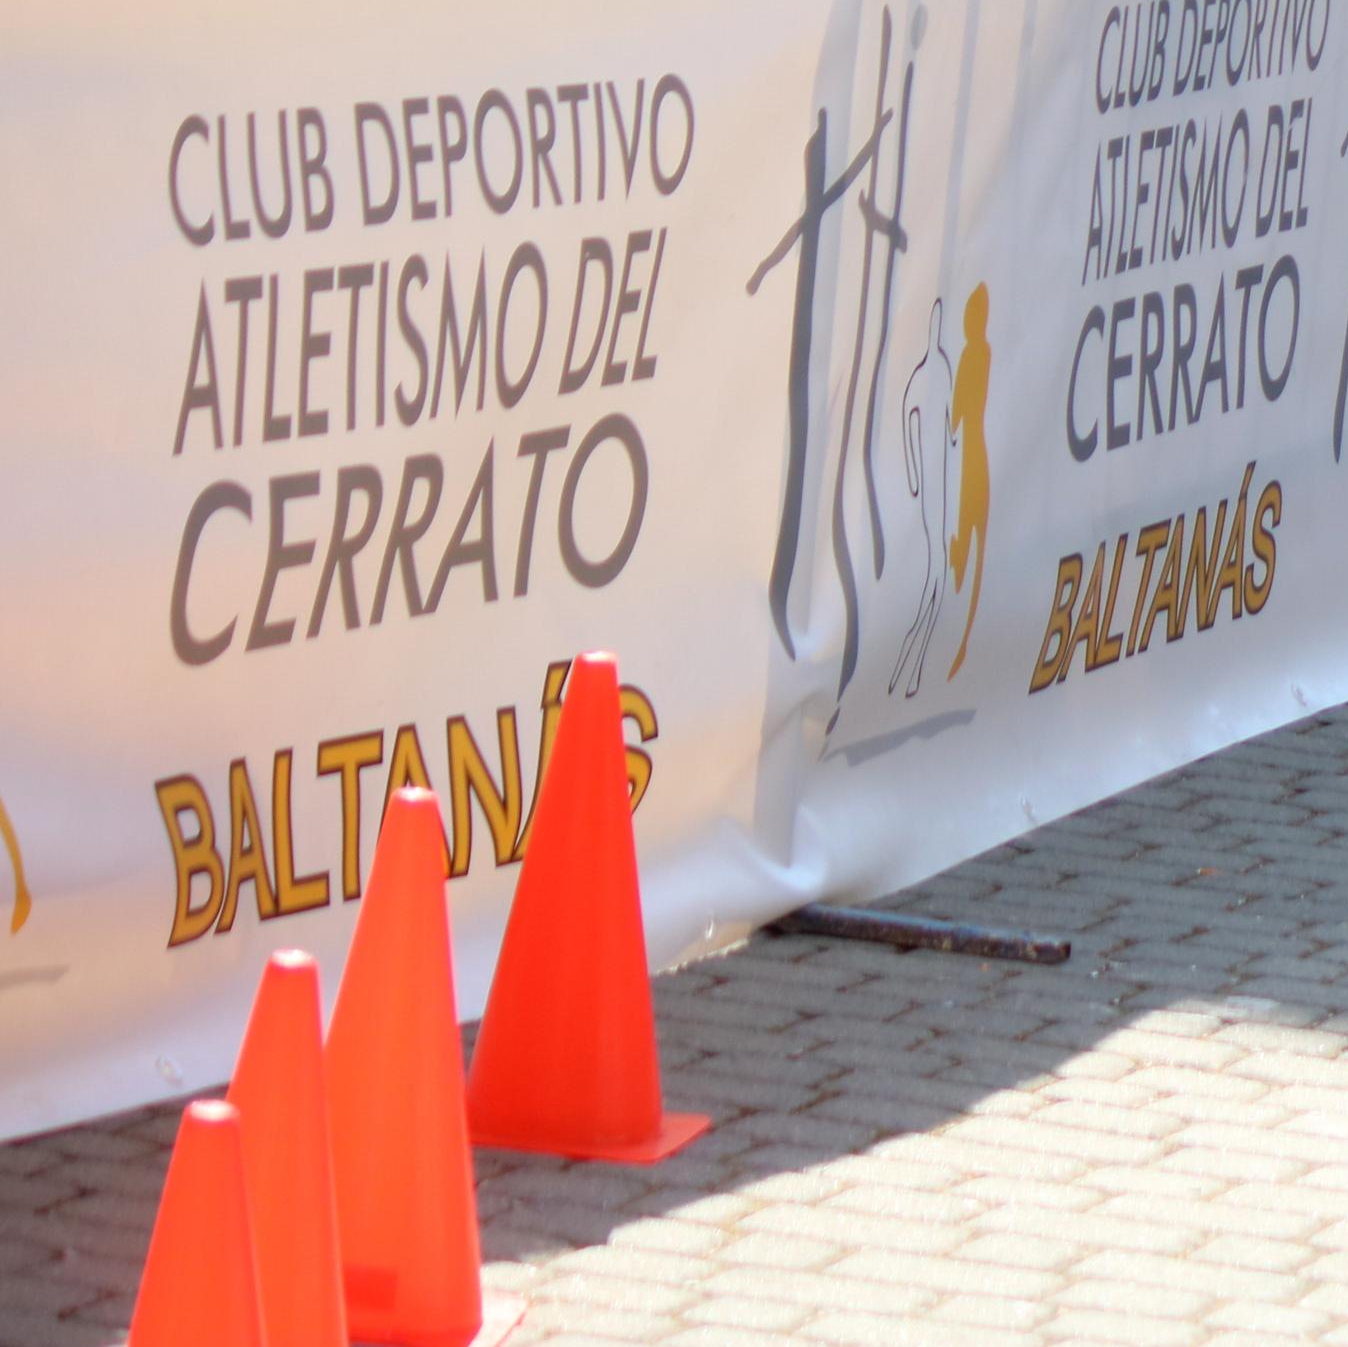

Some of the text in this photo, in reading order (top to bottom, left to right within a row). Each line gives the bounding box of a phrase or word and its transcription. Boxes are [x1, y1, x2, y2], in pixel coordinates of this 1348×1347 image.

[169, 73, 695, 247] CLUB DEPORTIVO
[1082, 97, 1313, 286] ATLETISMO DEL
[171, 227, 668, 456] ATLETISMO DEL
[1066, 254, 1300, 462] CERRATO
[169, 413, 649, 666] CERRATO
[1028, 460, 1283, 695] BALTANÁS
